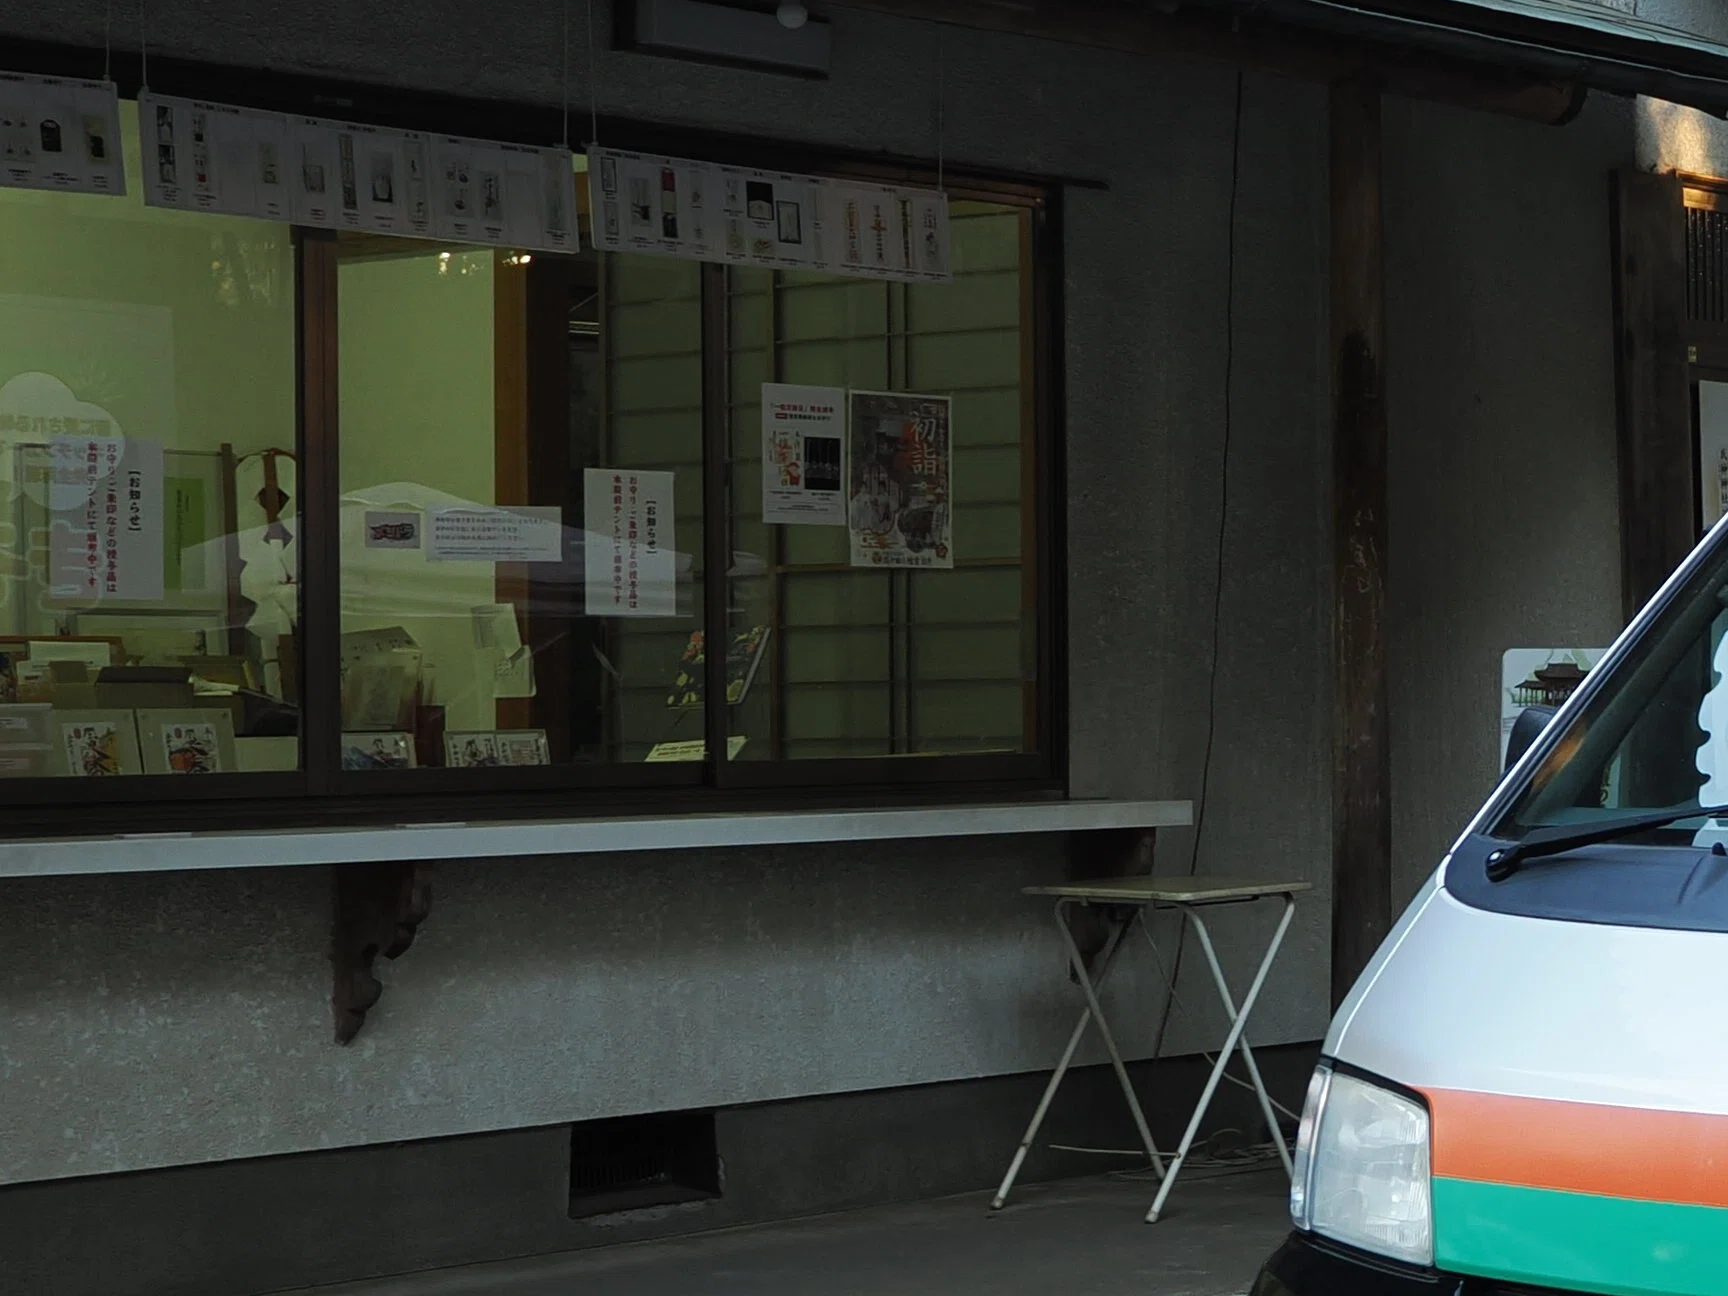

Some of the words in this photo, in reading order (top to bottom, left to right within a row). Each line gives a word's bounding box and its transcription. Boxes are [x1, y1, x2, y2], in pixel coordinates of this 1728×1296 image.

[909, 409, 938, 477] 初詣
[127, 469, 143, 533] 【お知らせ】
